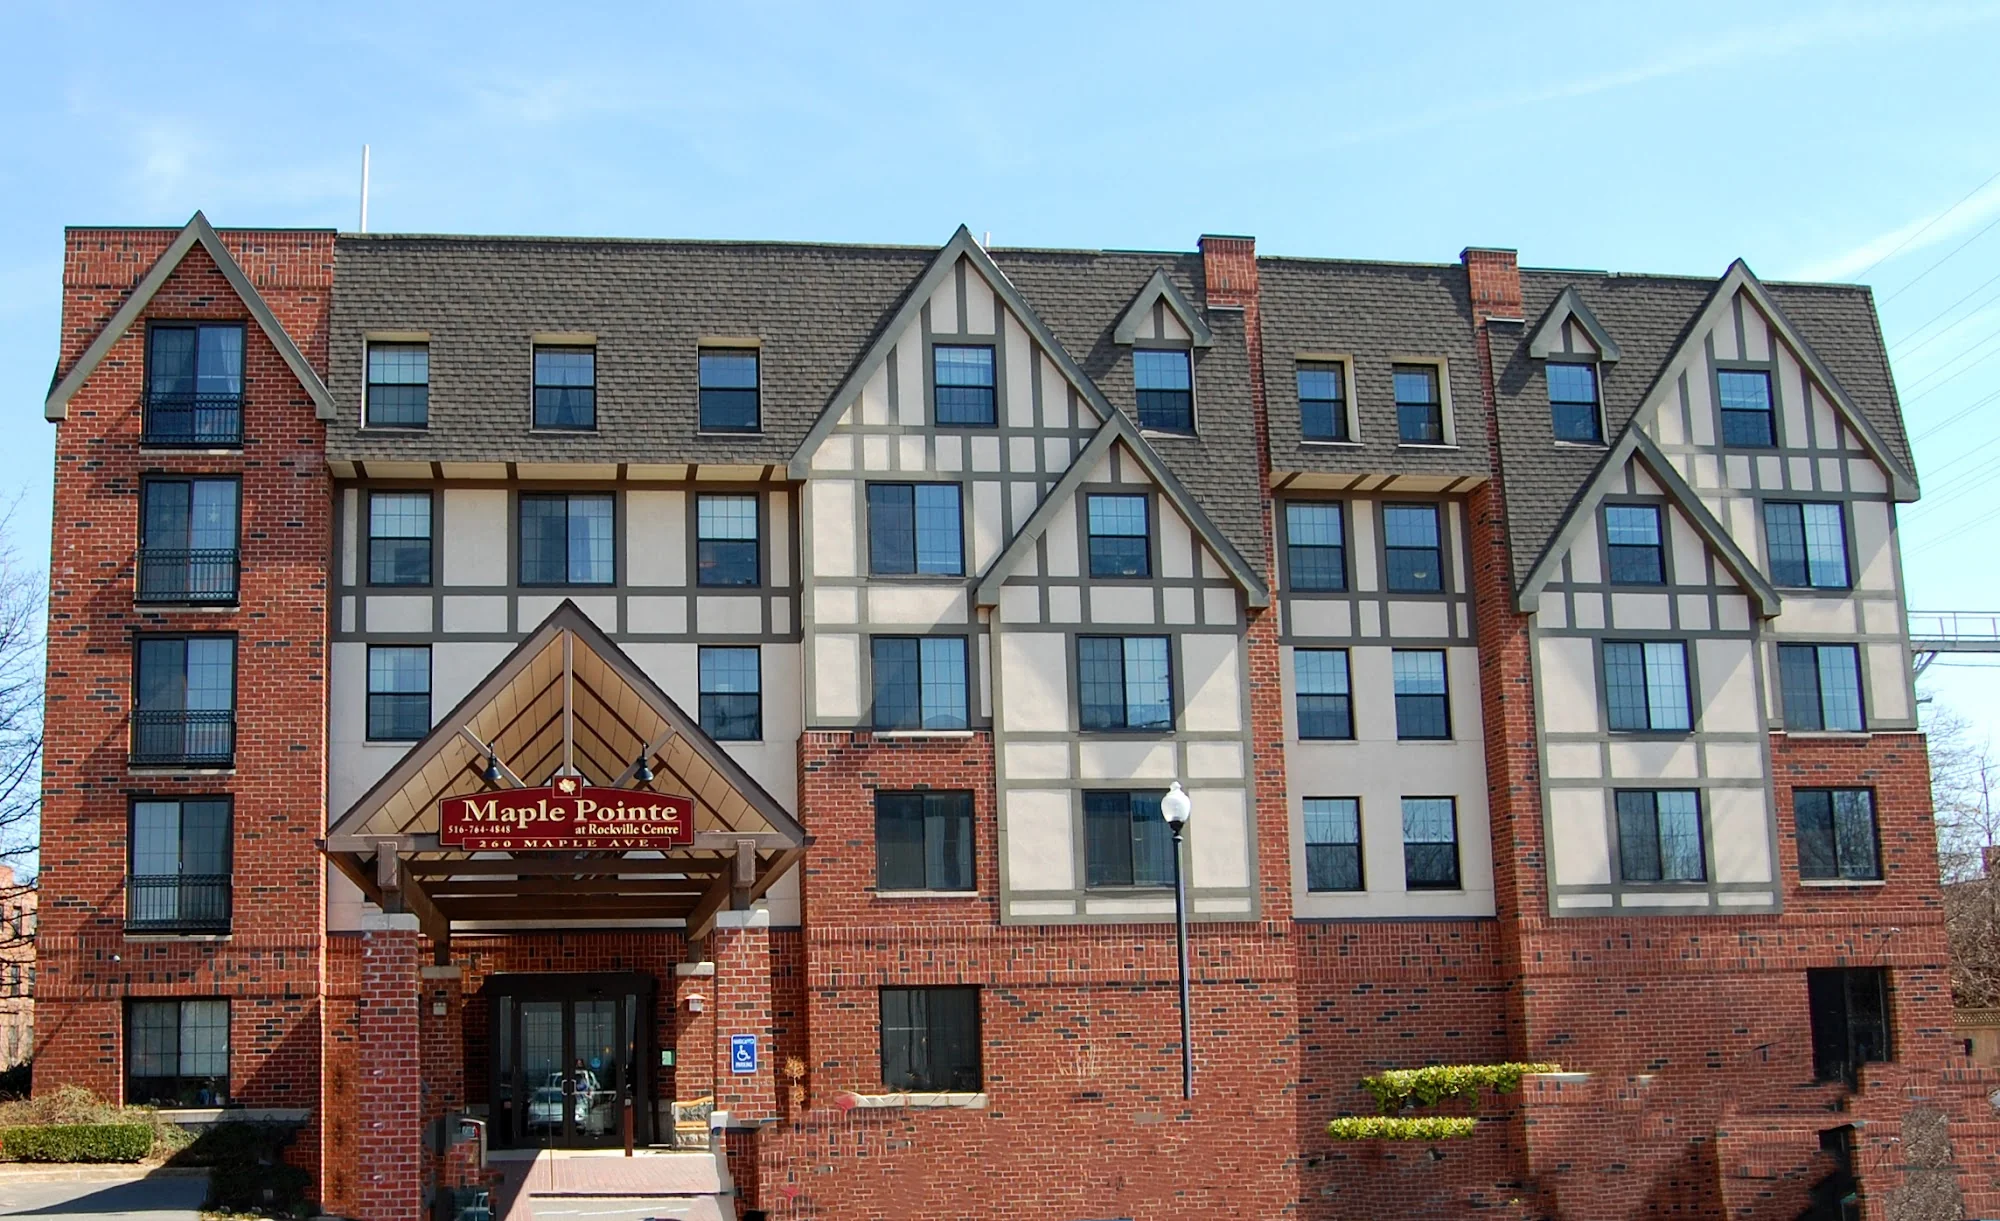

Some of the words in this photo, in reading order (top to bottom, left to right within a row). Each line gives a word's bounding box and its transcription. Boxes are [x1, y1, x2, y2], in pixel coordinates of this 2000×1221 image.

[461, 799, 566, 829] Maple
[573, 799, 678, 822] Pointe
[575, 825, 586, 835] at
[588, 823, 640, 835] Rockville
[641, 823, 679, 835] Centre
[479, 840, 512, 848] 260
[524, 840, 598, 848] MAPLE
[609, 839, 658, 848] AVE.
